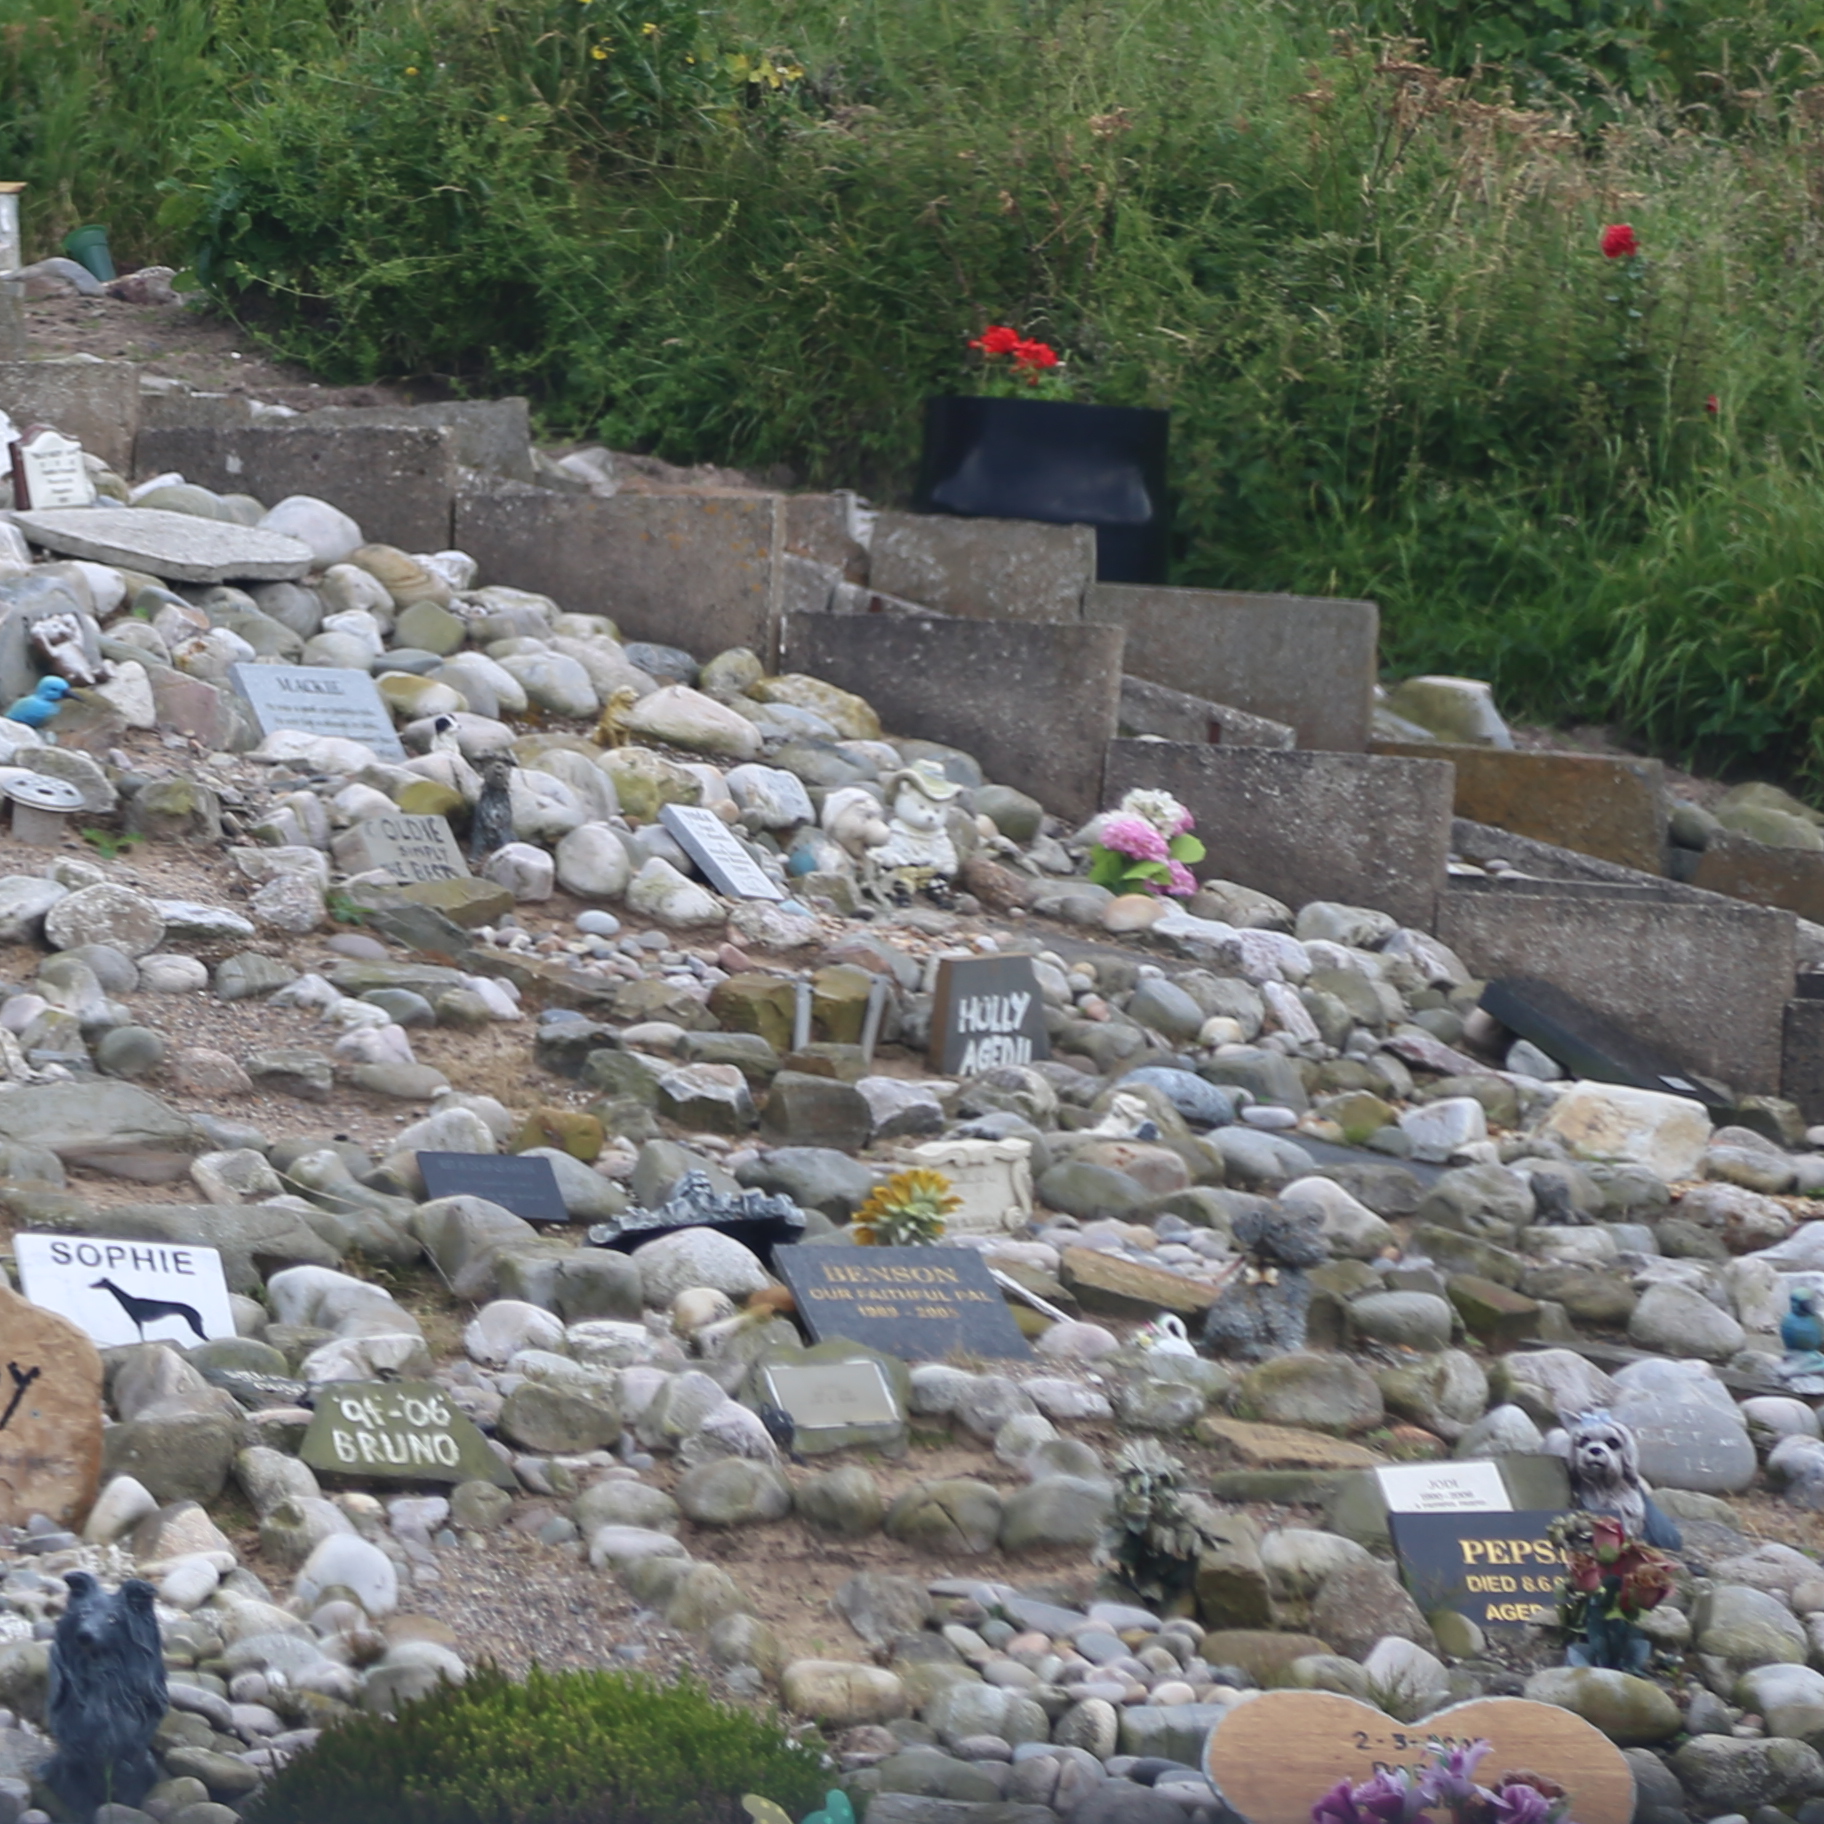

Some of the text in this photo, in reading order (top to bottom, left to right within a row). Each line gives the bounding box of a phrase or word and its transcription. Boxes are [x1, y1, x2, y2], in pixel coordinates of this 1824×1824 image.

[958, 991, 1031, 1033] HOLLY
[50, 1241, 196, 1276] SOPHIE
[822, 1264, 960, 1284] BENSON
[809, 1288, 854, 1301] OUR
[858, 1288, 952, 1303] FAITHFUL
[331, 1427, 461, 1468] BRUNO
[1458, 1538, 1569, 1566] PEPS
[1466, 1574, 1517, 1594] DIED
